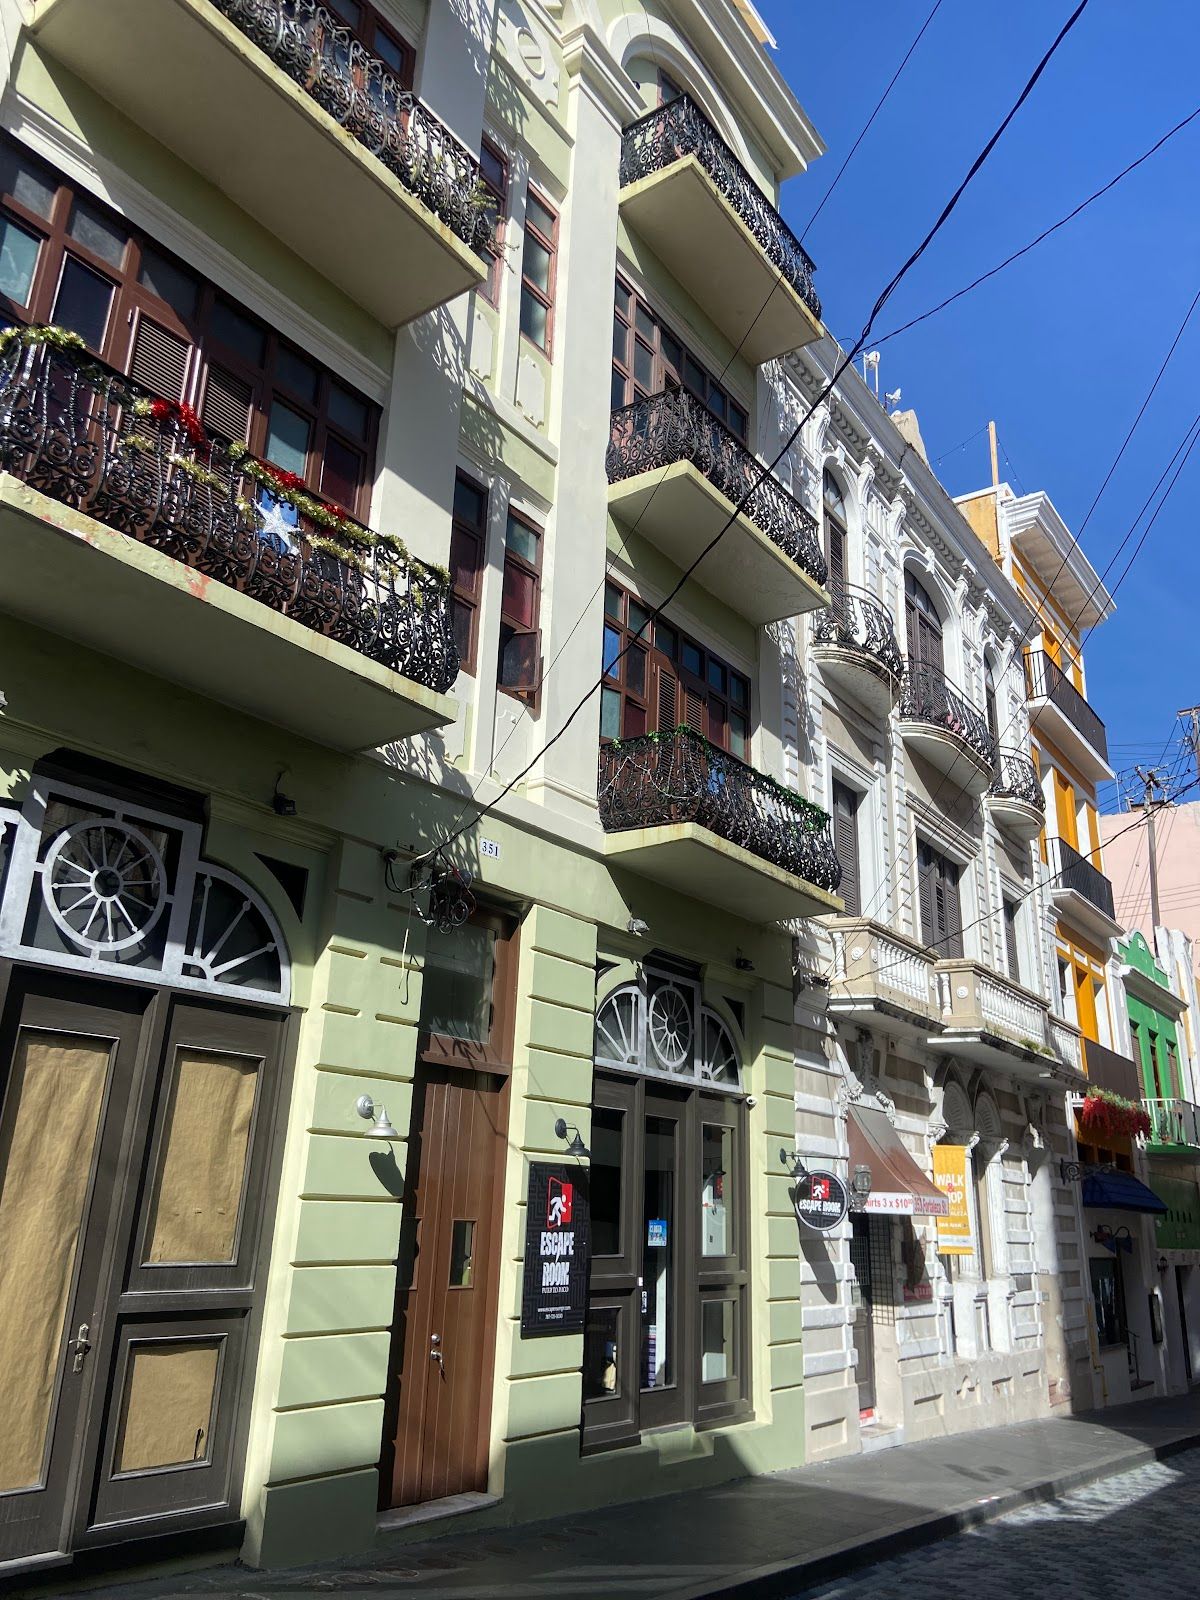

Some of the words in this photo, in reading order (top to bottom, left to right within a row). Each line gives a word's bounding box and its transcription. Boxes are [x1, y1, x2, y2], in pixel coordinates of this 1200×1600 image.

[482, 841, 498, 857] 351
[935, 1174, 964, 1187] WALK
[947, 1183, 953, 1193] &
[882, 1197, 887, 1208] 3
[888, 1199, 894, 1208] x
[945, 1191, 964, 1204] HOP
[799, 1199, 822, 1213] ESCAPE
[822, 1201, 841, 1213] ROOM
[540, 1231, 575, 1257] ESCAPE
[542, 1262, 570, 1287] ROOM
